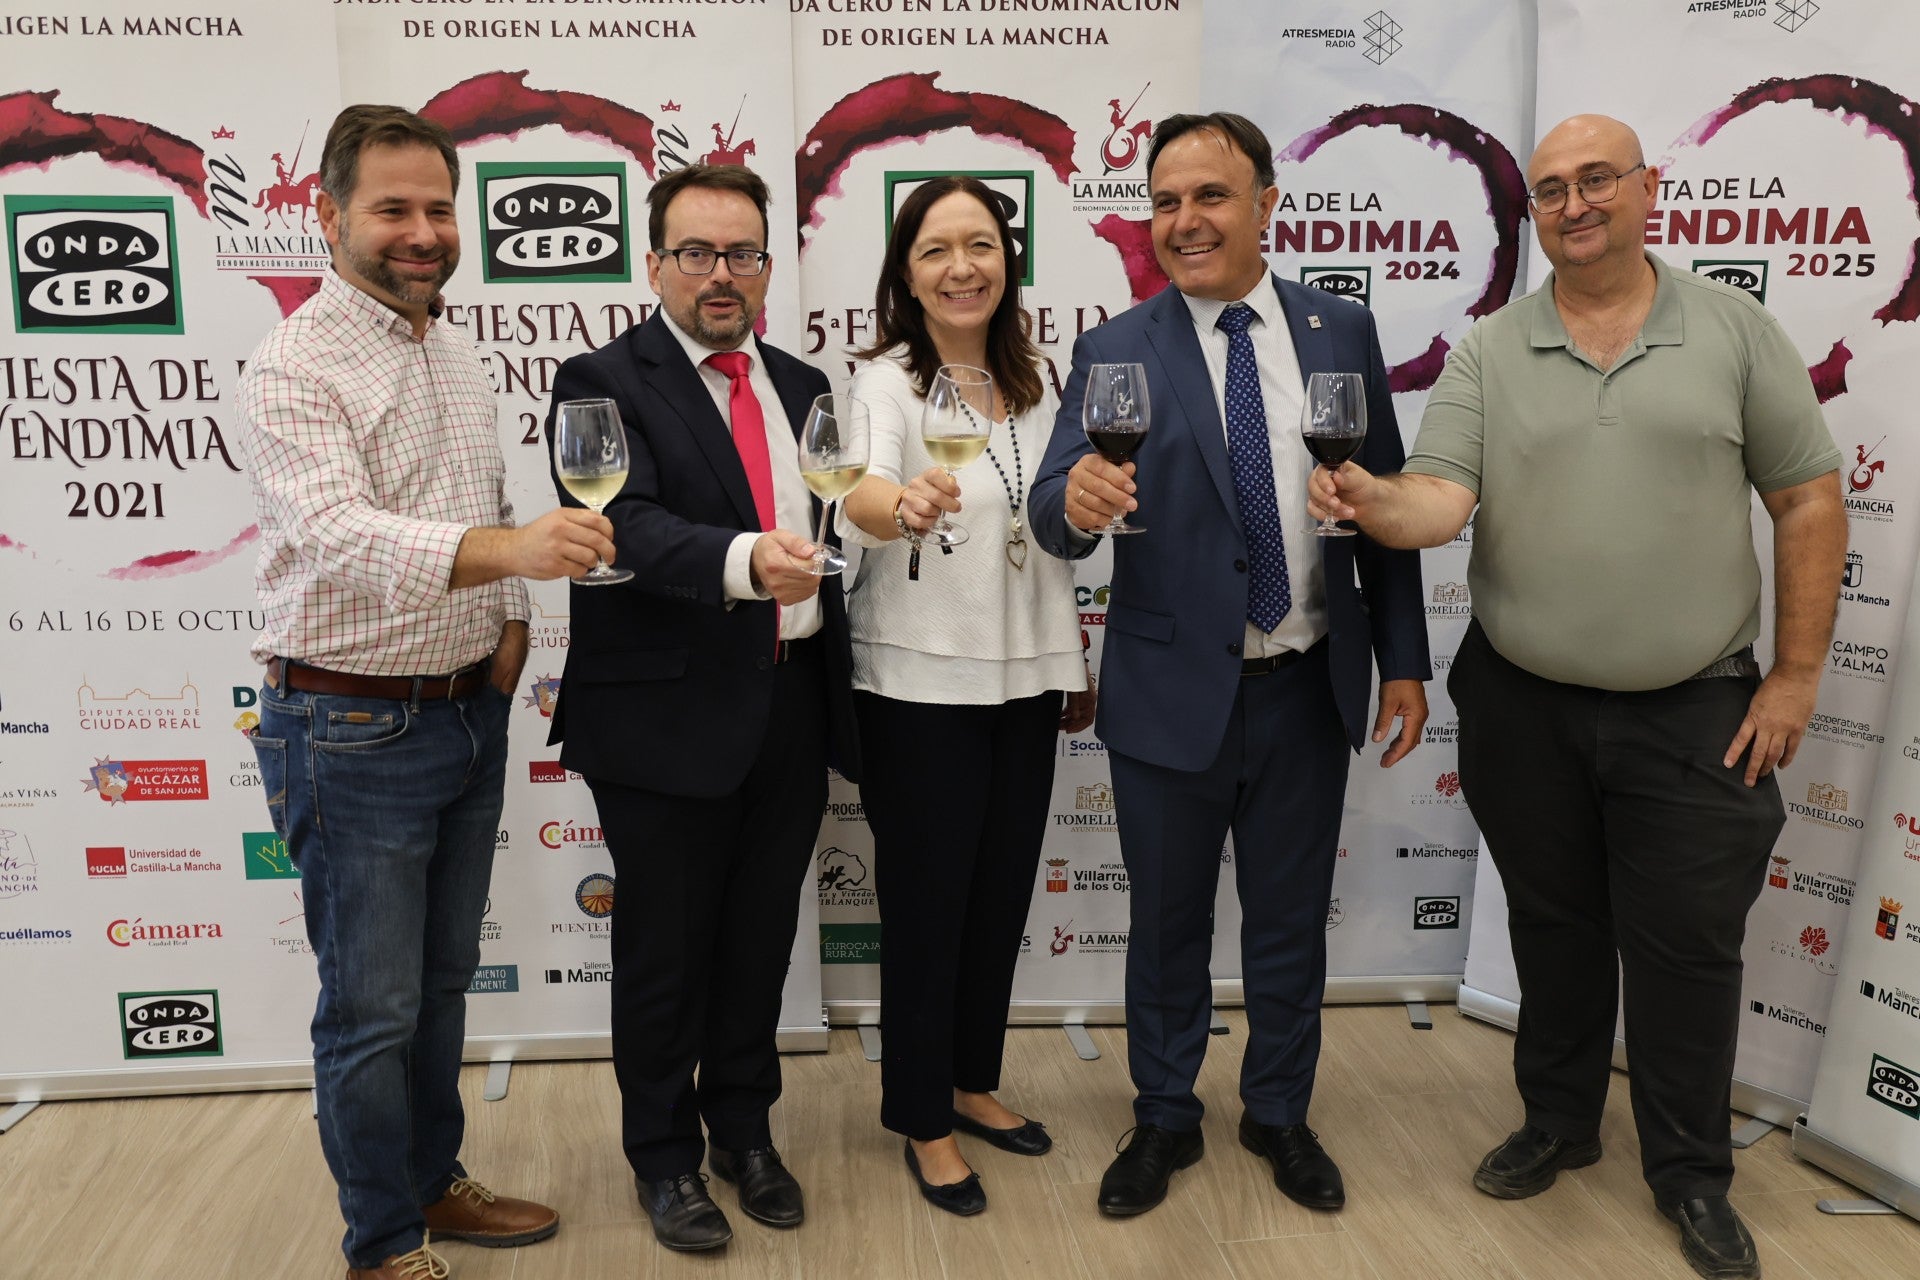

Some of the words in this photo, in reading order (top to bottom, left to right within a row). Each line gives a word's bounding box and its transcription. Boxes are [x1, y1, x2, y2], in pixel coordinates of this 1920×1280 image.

[1733, 8, 1767, 19] RADIO
[0, 16, 69, 36] IGEN
[80, 16, 115, 36] LA
[123, 17, 244, 36] MANCHA
[404, 20, 436, 38] DE
[443, 19, 541, 38] ORIGEN
[551, 20, 581, 38] LA
[588, 20, 697, 38] MANCHA
[822, 28, 853, 46] DE
[861, 28, 956, 46] ORIGEN
[966, 28, 994, 45] LA
[1003, 27, 1110, 45] MANCHA
[1282, 28, 1356, 39] ATRESMEDIA
[1325, 40, 1356, 48] RADIO
[1073, 184, 1094, 198] LA
[1097, 184, 1151, 198] MANC
[1702, 178, 1740, 200] DE
[1749, 177, 1786, 199] LA
[505, 197, 601, 218] ONDA
[1306, 193, 1341, 212] DE
[1351, 193, 1383, 212] LA
[36, 235, 148, 259] ONDA
[216, 235, 243, 254] LA
[245, 235, 328, 255] MANCHA
[512, 235, 603, 259] CERO
[1385, 260, 1460, 280] 2024
[1786, 253, 1877, 277] 2025
[1312, 280, 1358, 290] ONDA
[47, 280, 151, 306] CERO
[446, 302, 599, 351] FIESTA
[0, 355, 152, 413] IESTA
[149, 359, 221, 402] DE
[65, 481, 166, 519] 2021
[1856, 592, 1890, 606] Mancha
[9, 610, 24, 632] 6
[36, 610, 73, 631] AL
[85, 610, 112, 632] 16
[126, 610, 165, 631] DE
[1832, 640, 1889, 660] CAMPO
[1832, 655, 1886, 676] YALMA
[80, 708, 173, 718] DIPUTACIÓN
[183, 708, 201, 717] DE
[1, 722, 50, 738] Mancha
[80, 718, 153, 730] CIUDAD
[159, 718, 202, 730] REAL
[137, 766, 189, 775] ayuntamiento
[190, 766, 200, 774] de
[133, 773, 200, 786] ALCÁZAR
[0, 791, 14, 799] AS
[17, 789, 57, 798] VIÑAS
[140, 788, 153, 796] DE
[155, 788, 174, 796] SAN
[175, 787, 202, 796] JUAN
[1053, 814, 1118, 826] TOMELL
[1788, 802, 1864, 830] TOMELLOSO
[129, 849, 187, 860] Universidad
[189, 848, 202, 858] de
[1412, 847, 1479, 860] Manchegos
[96, 865, 126, 874] UCLM
[130, 861, 182, 873] Castilla-La
[183, 861, 222, 873] Mancha
[1073, 870, 1129, 882] Villarru
[1073, 881, 1088, 891] de
[1091, 881, 1109, 891] los
[1792, 882, 1805, 893] de
[1808, 885, 1824, 898] los
[1827, 892, 1851, 906] Ojos
[819, 898, 875, 906] IBLANQUE
[1423, 915, 1452, 923] CERO
[106, 917, 224, 947] Cámara
[551, 922, 606, 934] PUENTE
[268, 937, 304, 946] Tierra
[1079, 934, 1094, 945] LA
[288, 944, 299, 954] de
[825, 950, 863, 958] RURAL
[583, 961, 611, 970] Talleres
[1877, 989, 1920, 1020] Manc
[137, 1006, 203, 1020] ONDA
[143, 1029, 205, 1045] CERO
[1879, 1068, 1915, 1089] ONDA
[1878, 1084, 1912, 1105] CERO
